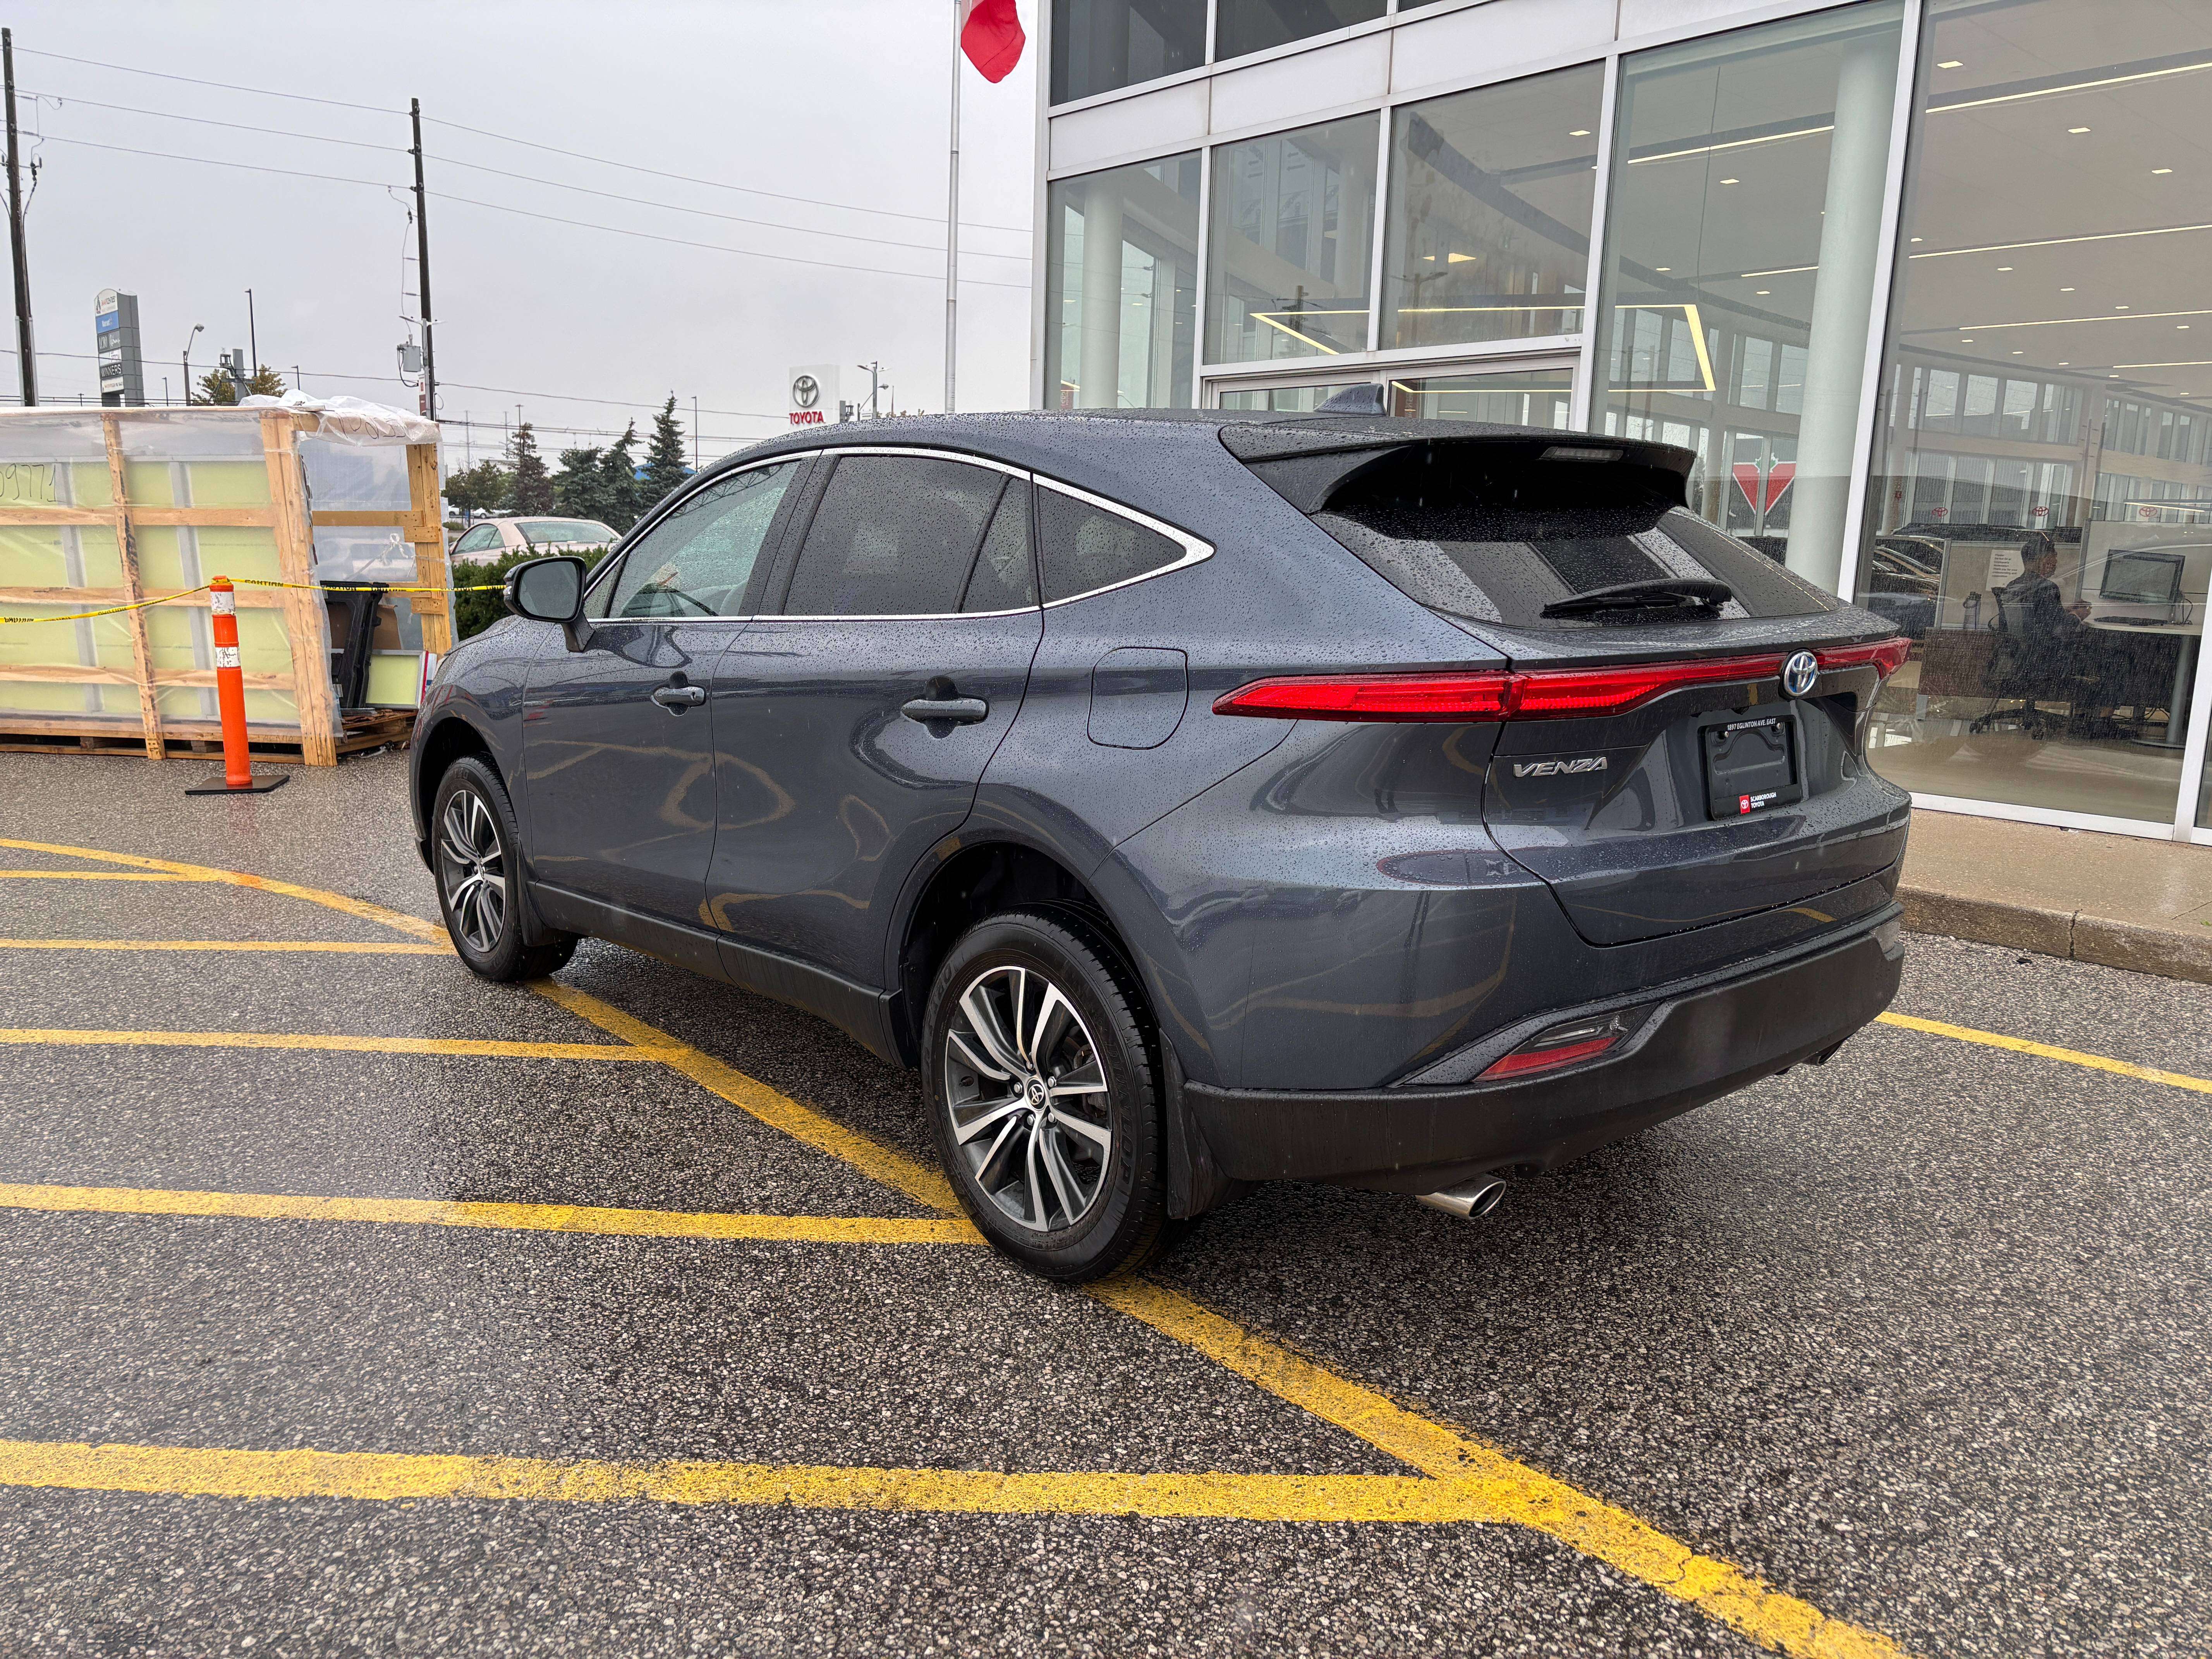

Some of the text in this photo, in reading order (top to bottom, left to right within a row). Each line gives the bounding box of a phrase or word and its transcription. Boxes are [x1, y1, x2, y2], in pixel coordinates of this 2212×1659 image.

[100, 364, 121, 377] WINNERS
[789, 411, 824, 424] TOYOTA
[1737, 721, 1757, 729] EGLINTON
[1513, 756, 1607, 777] VENZA
[1750, 792, 1777, 802] SCARBOROUGH
[1104, 1041, 1134, 1185] DUNLOP
